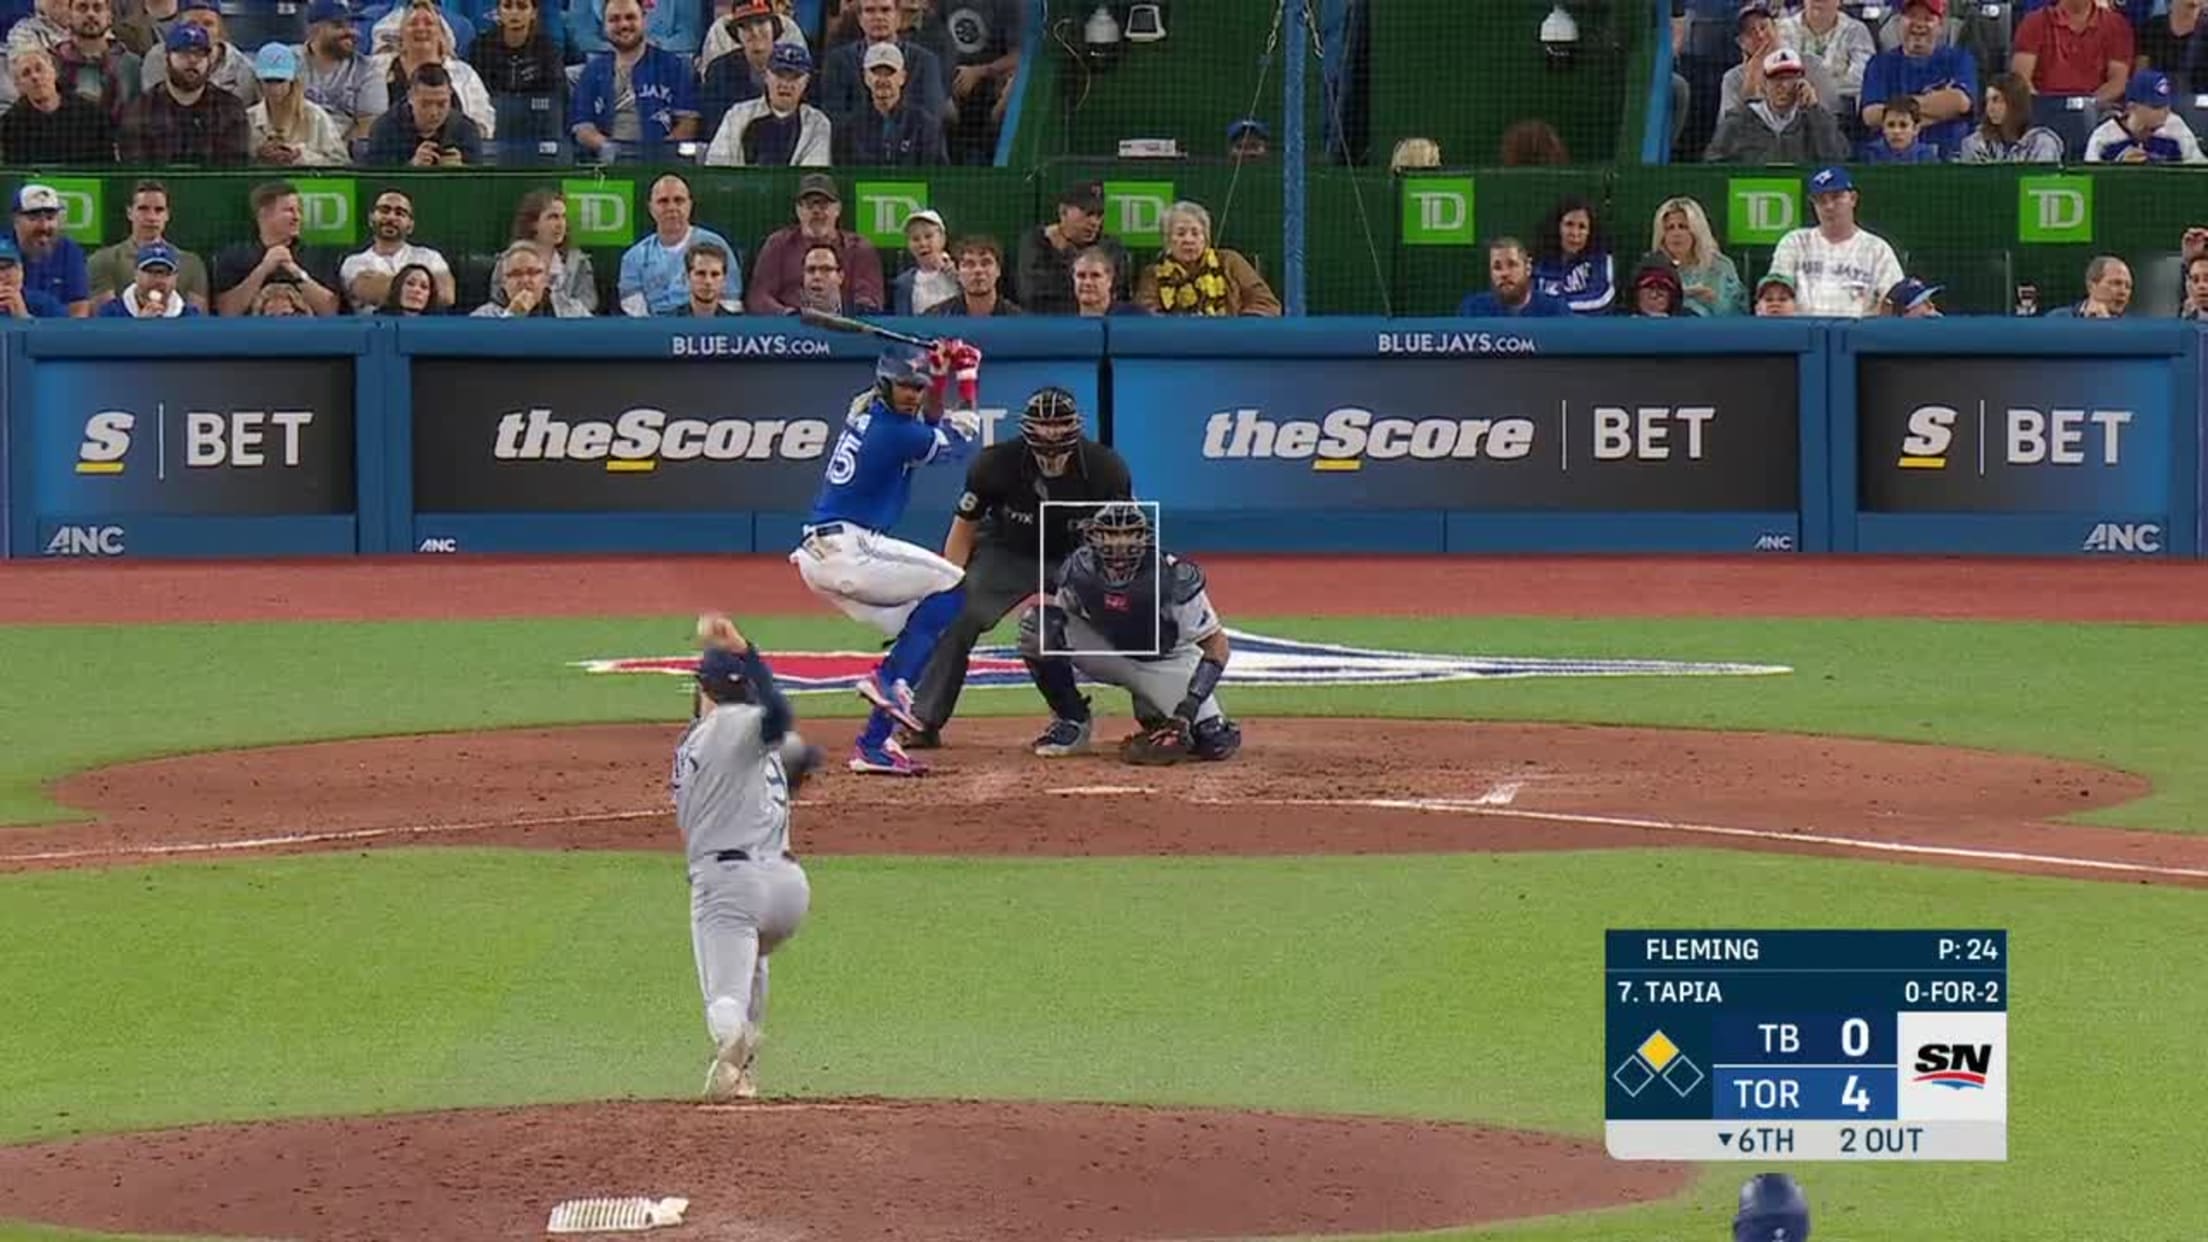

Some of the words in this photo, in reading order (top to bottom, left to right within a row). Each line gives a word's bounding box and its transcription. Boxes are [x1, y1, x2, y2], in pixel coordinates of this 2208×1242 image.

[568, 193, 626, 231] TD
[1410, 192, 1466, 230] TD
[1736, 191, 1793, 231] TD
[2028, 190, 2085, 228] TD
[186, 412, 314, 467] BET
[493, 409, 830, 460] theScore
[1202, 407, 1535, 460] theScore
[1593, 407, 1716, 460] BET
[2007, 409, 2134, 465] BET
[43, 525, 125, 555] ANC
[419, 538, 456, 553] ANC
[1753, 535, 1793, 551] ANC
[2083, 523, 2160, 553] ANC
